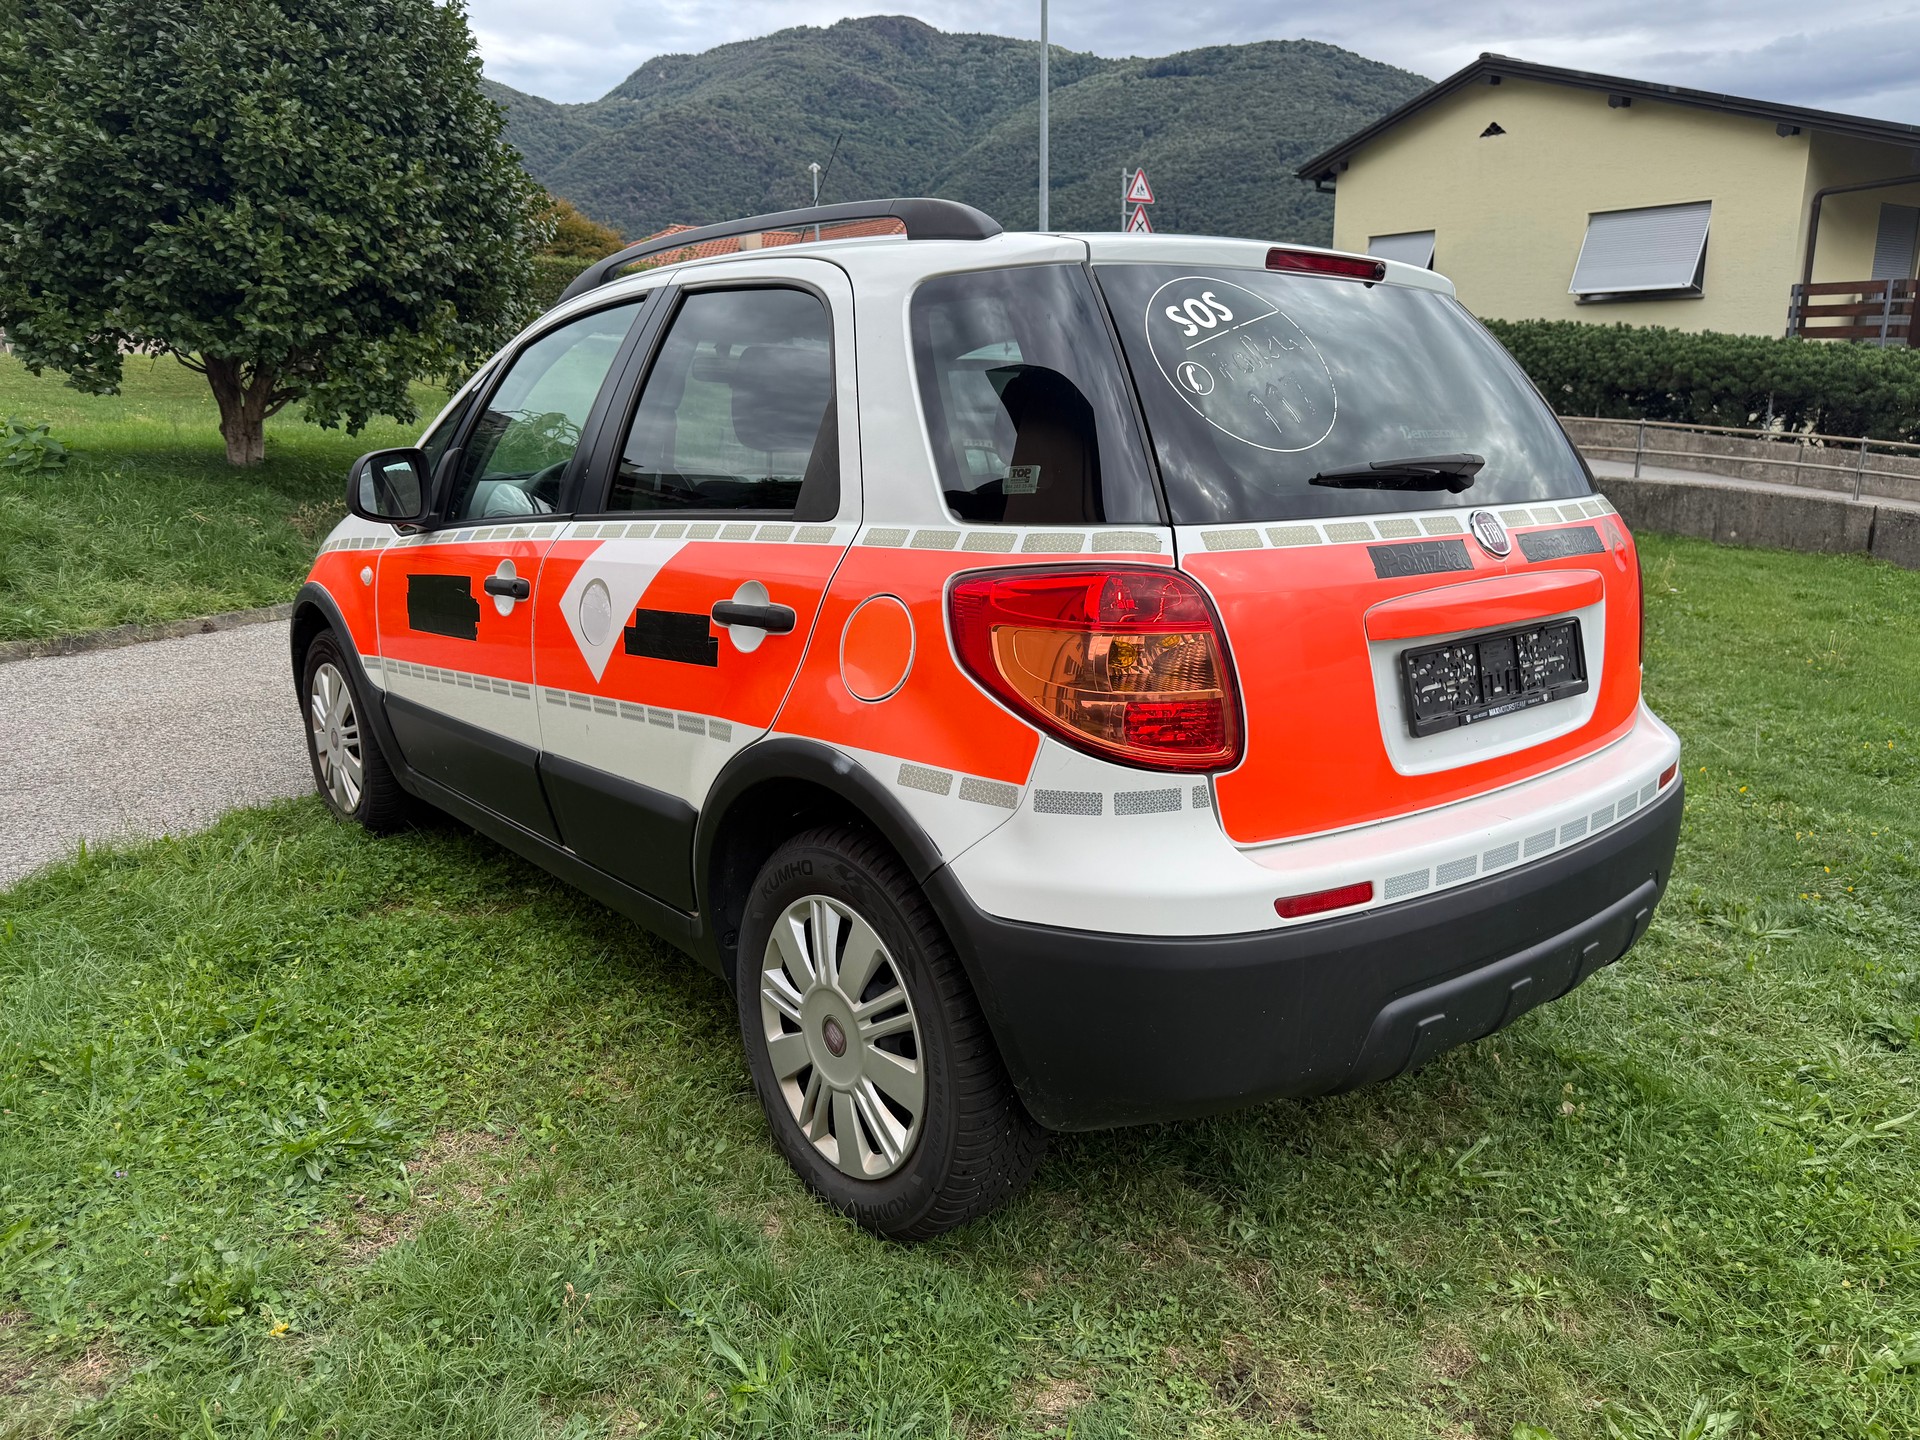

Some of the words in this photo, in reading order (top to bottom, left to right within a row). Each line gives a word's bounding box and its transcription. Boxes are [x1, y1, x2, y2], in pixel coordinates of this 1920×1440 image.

[1165, 291, 1234, 337] SOS
[1480, 522, 1506, 544] FIAT
[760, 859, 814, 900] KUMHO
